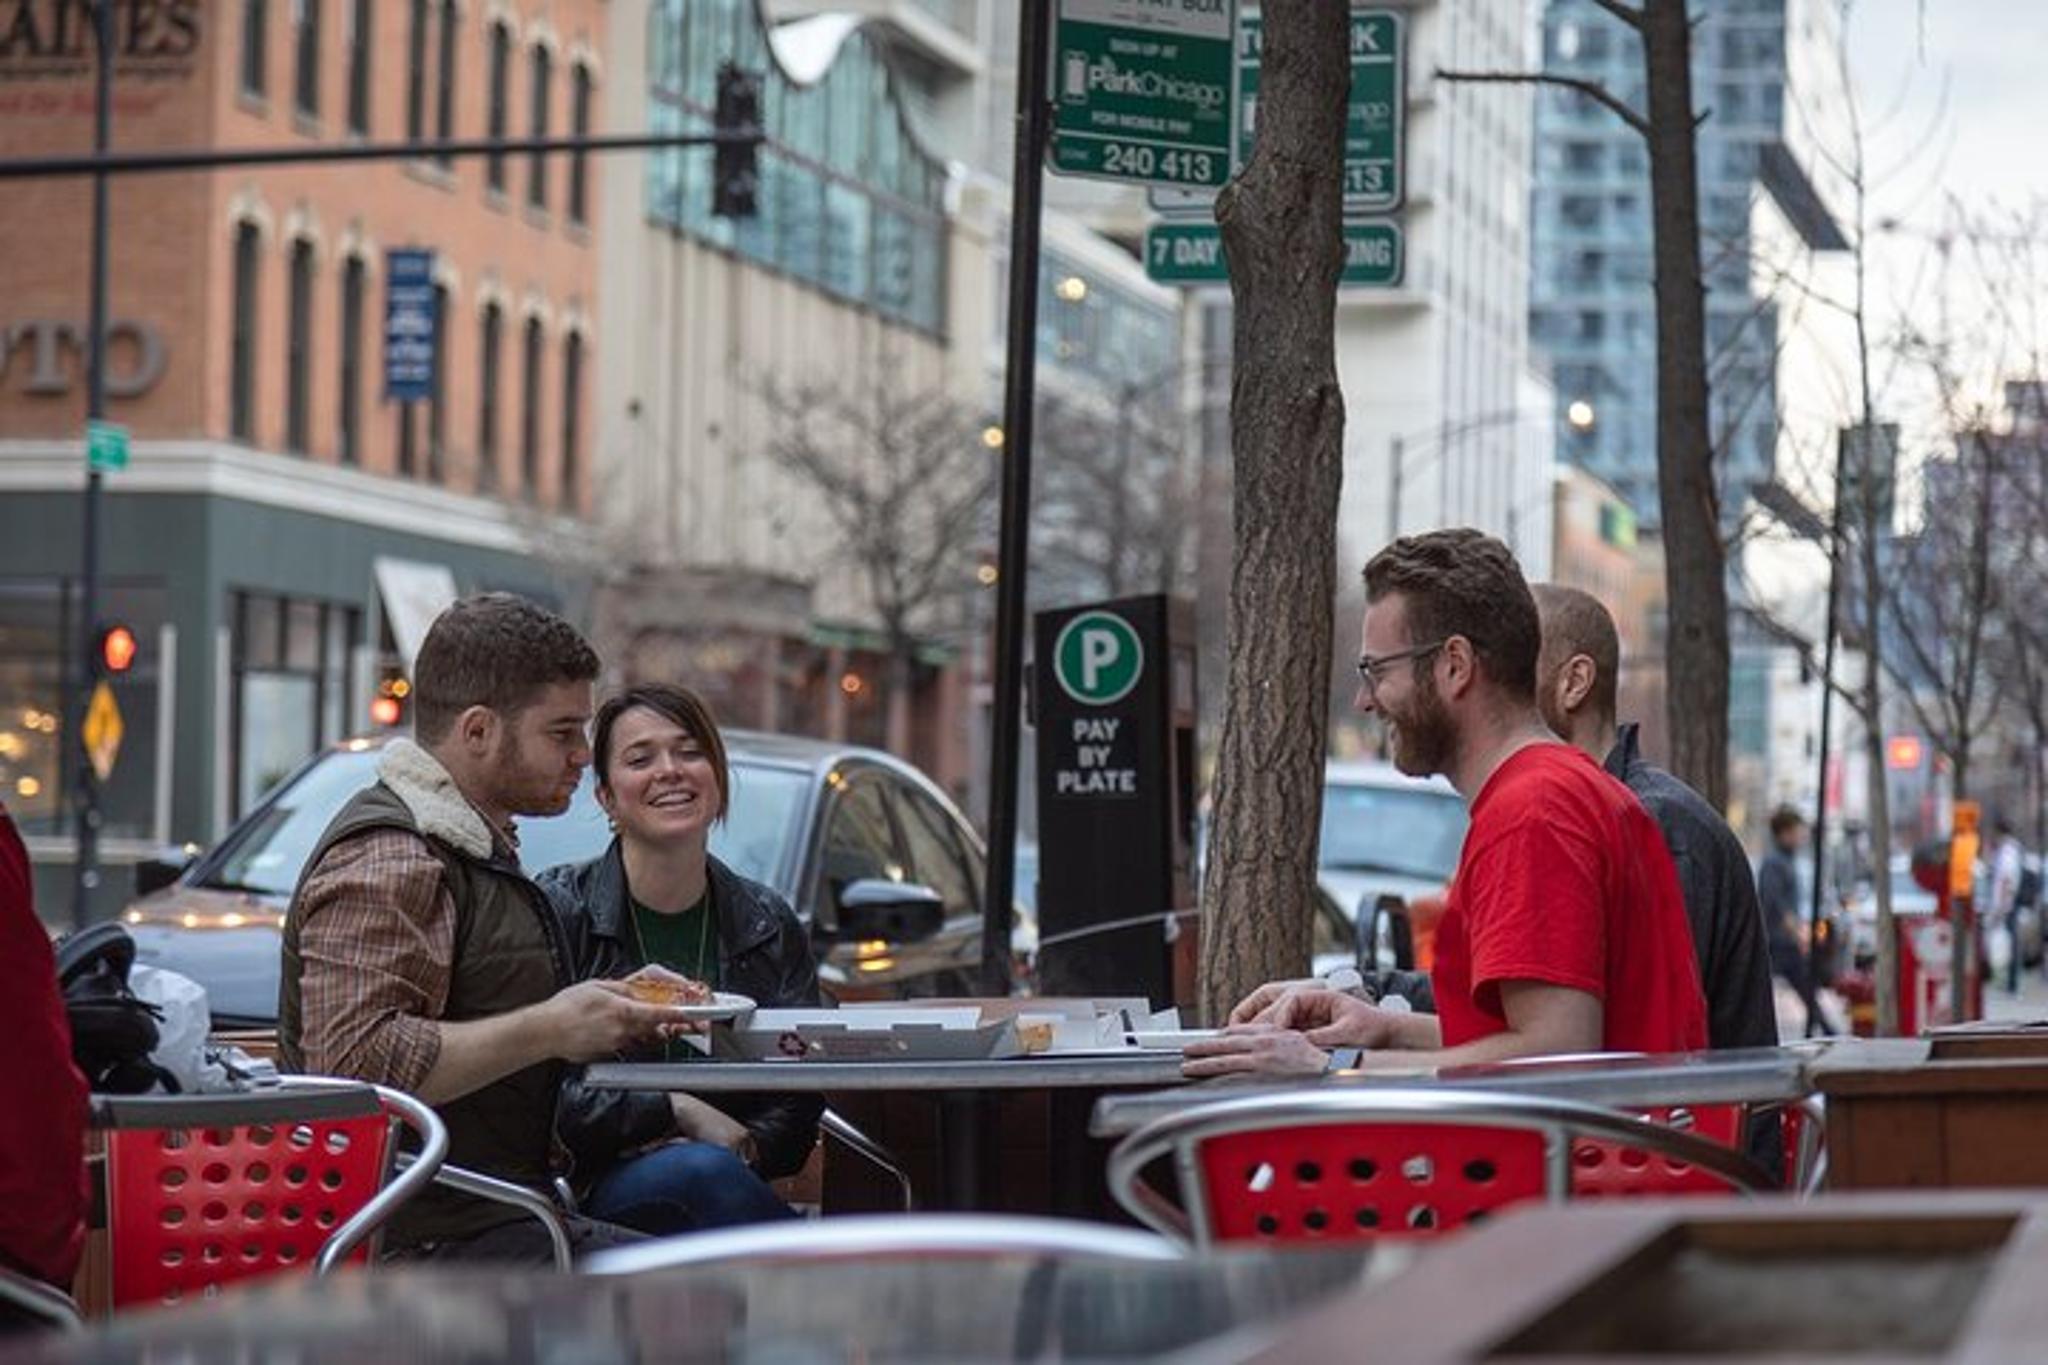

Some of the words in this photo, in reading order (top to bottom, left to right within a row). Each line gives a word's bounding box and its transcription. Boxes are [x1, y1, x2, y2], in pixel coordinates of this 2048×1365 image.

[1088, 63, 1224, 107] ParkChicago
[1103, 143, 1155, 175] 240
[1160, 151, 1212, 182] 413
[1153, 238, 1169, 265] 7
[1174, 238, 1219, 266] DAY
[1081, 628, 1120, 690] P
[1073, 718, 1120, 741] PAY
[1078, 746, 1111, 768] BY
[1057, 770, 1136, 793] PLATE
